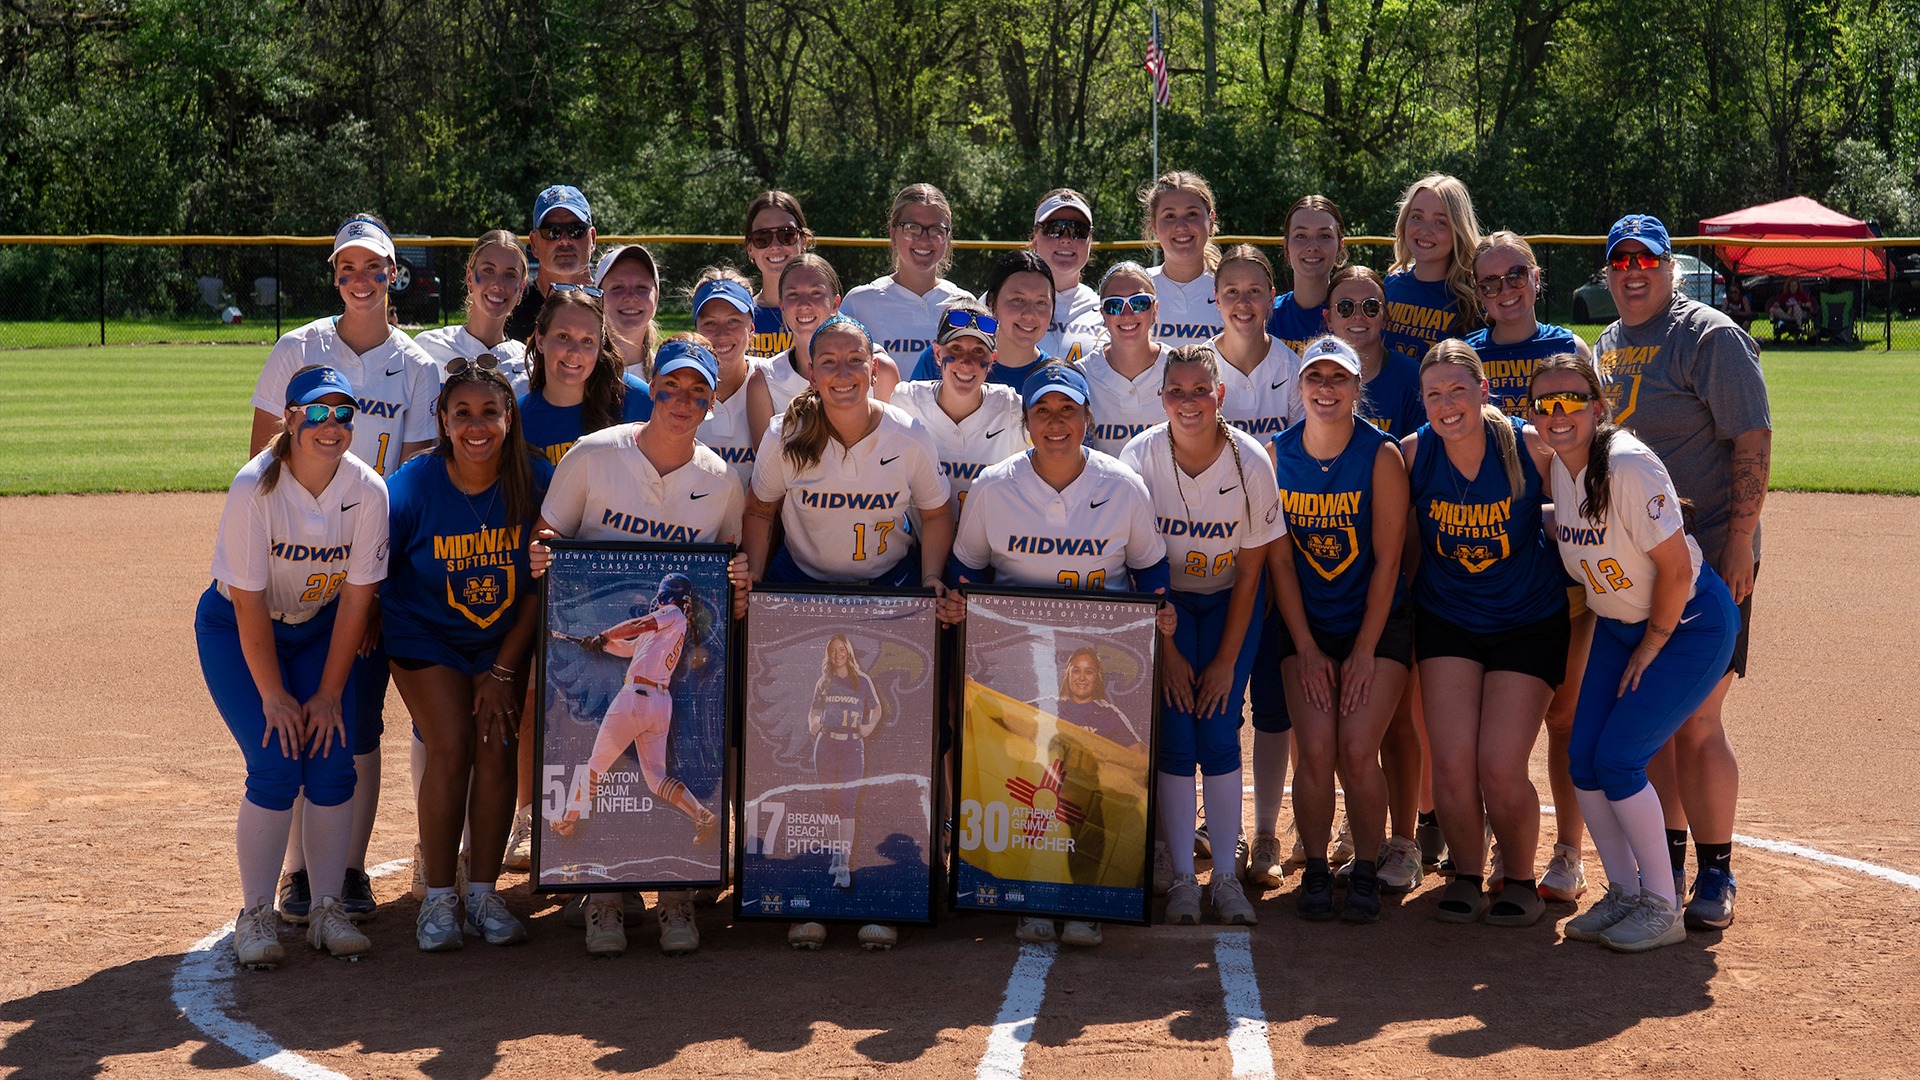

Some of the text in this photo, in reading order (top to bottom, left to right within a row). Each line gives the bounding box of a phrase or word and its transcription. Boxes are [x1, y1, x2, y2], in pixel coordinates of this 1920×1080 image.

[1387, 301, 1457, 333] MIDWAY
[1151, 322, 1224, 340] IDWAY
[1386, 321, 1437, 341] SOFTBALL
[801, 489, 901, 510] MIDWAY
[1279, 488, 1362, 517] MIDWAY
[1428, 496, 1511, 527] MIDWAY
[601, 508, 702, 543] MIDWAY
[1290, 513, 1353, 529] SOFTBALL
[1439, 522, 1506, 539] SOFTBALL
[433, 524, 522, 560] MIDWAY
[852, 519, 895, 561] 17
[1007, 533, 1110, 556] MIDWAY
[446, 552, 514, 572] SOFTBALL
[551, 552, 726, 563] MIDWAY UNIVERSITY SOFTBALL
[592, 562, 629, 570] CLASS
[1580, 557, 1634, 595] 12
[752, 595, 934, 608] MIDWAY UNIVERSITY SOFTBALL
[793, 605, 832, 614] CLASS
[970, 597, 1155, 614] MIDWAY UNIVERSITY SOFTBALL
[1012, 608, 1051, 616] CLASS
[1084, 613, 1114, 621] 2026
[825, 695, 860, 705] MIDWAY
[842, 709, 859, 728] 17
[597, 772, 639, 784] PAYTON
[542, 764, 592, 821] 54
[596, 785, 629, 797] BAUM
[596, 797, 653, 813] INFIELD
[1012, 807, 1057, 820] ATHENA
[787, 813, 840, 825] BREANNA
[959, 799, 1009, 852] 30
[1011, 819, 1060, 832] GRIMLEY
[746, 801, 785, 855] 17
[787, 826, 825, 837] BEACH
[787, 839, 851, 855] PITCHER
[1011, 834, 1075, 853] PITCHER
